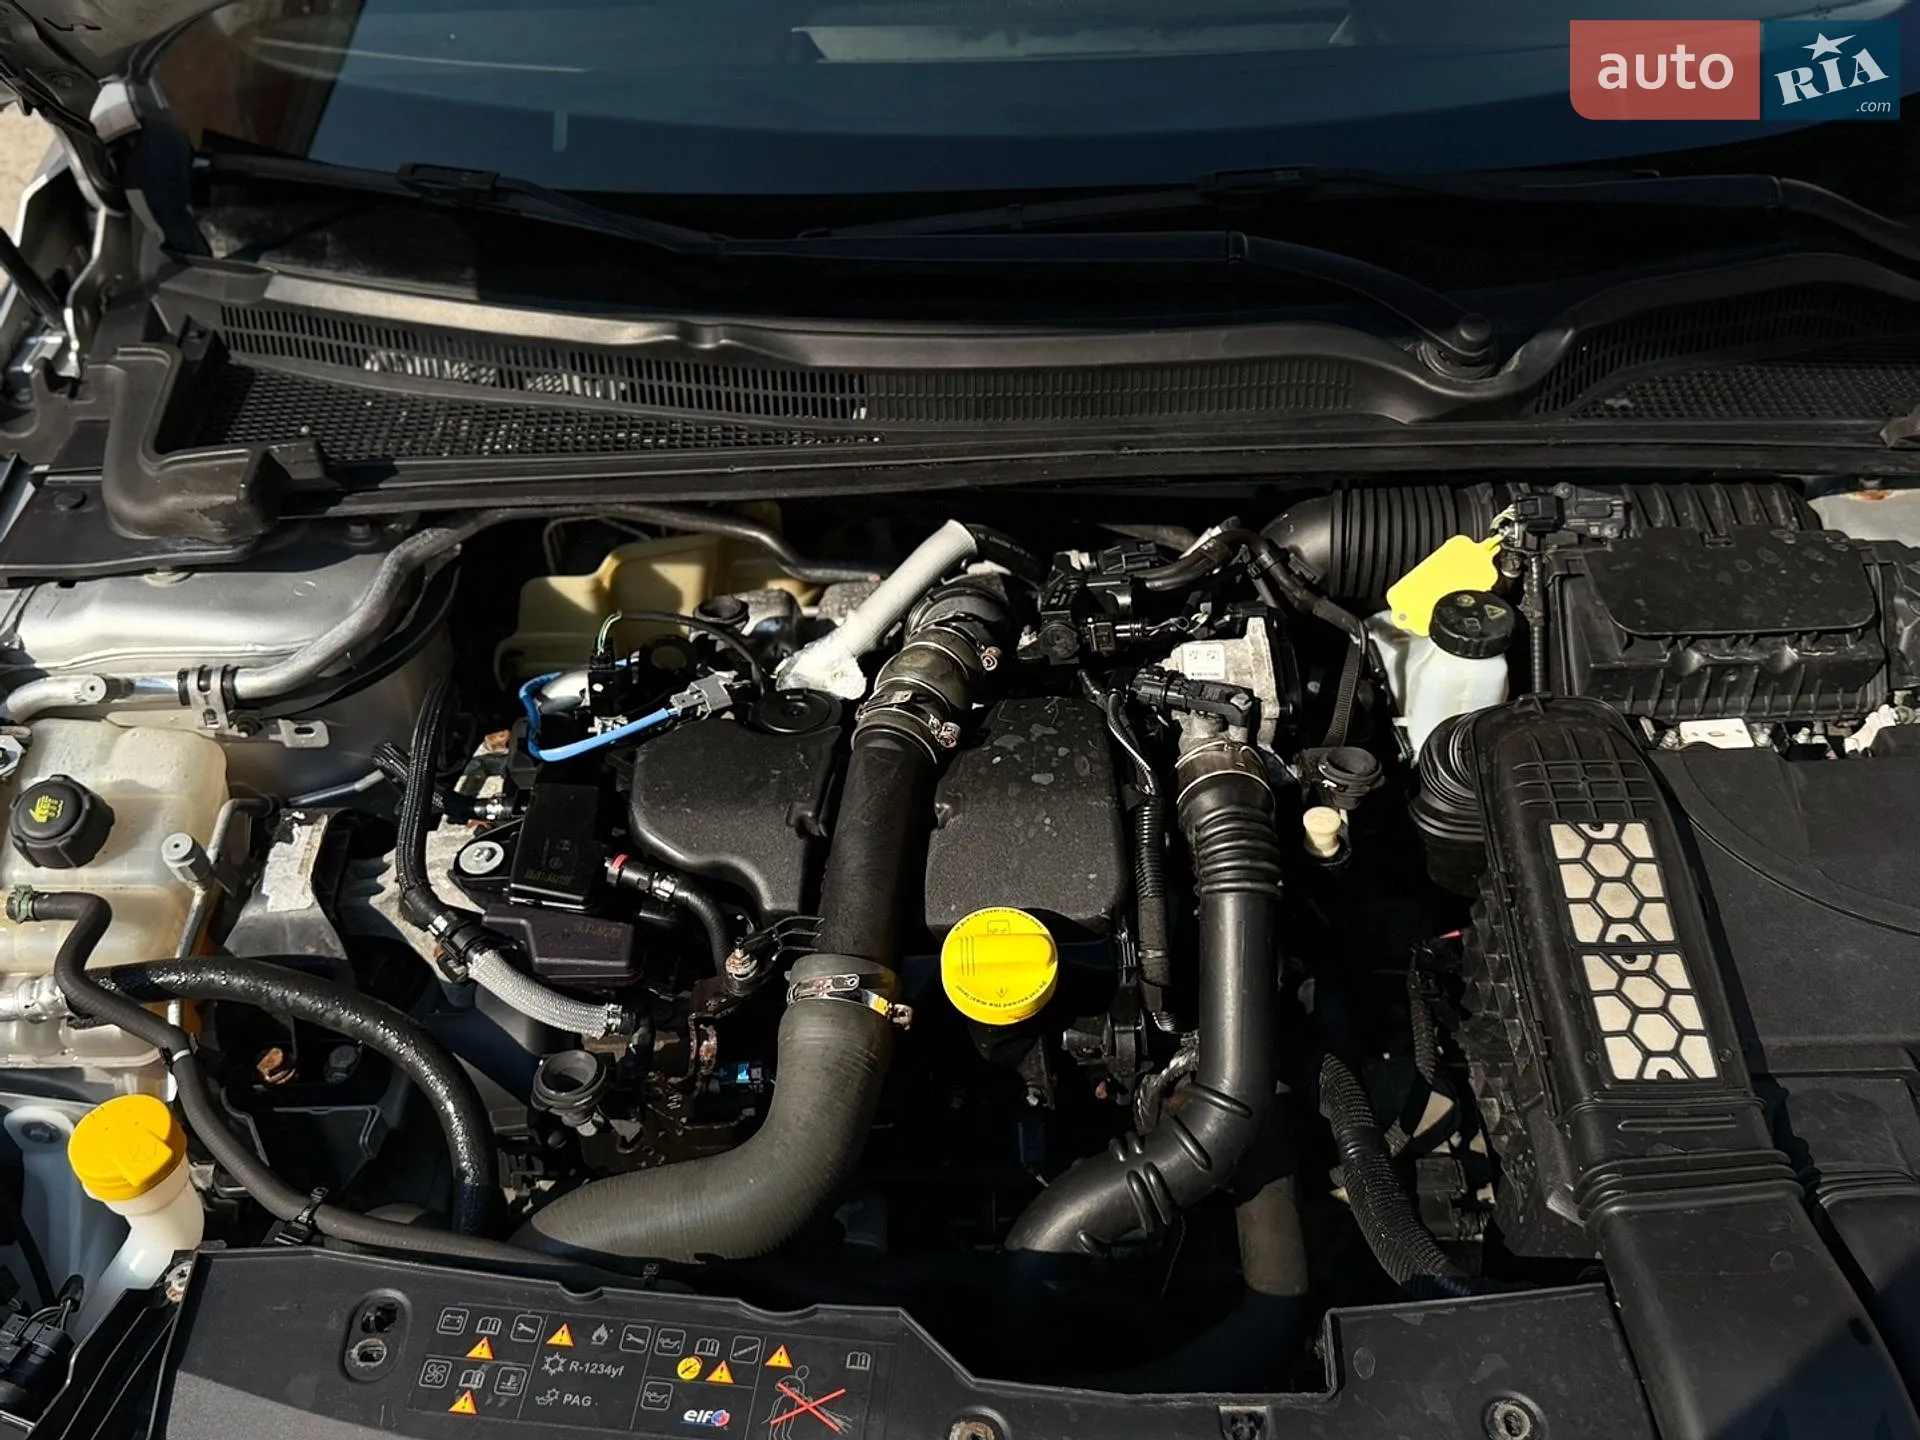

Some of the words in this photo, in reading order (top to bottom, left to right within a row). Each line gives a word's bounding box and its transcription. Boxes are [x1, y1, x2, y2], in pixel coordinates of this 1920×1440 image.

[569, 1360, 625, 1378] R-1234yf
[562, 1393, 592, 1407] PAG
[683, 1409, 714, 1423] elf
